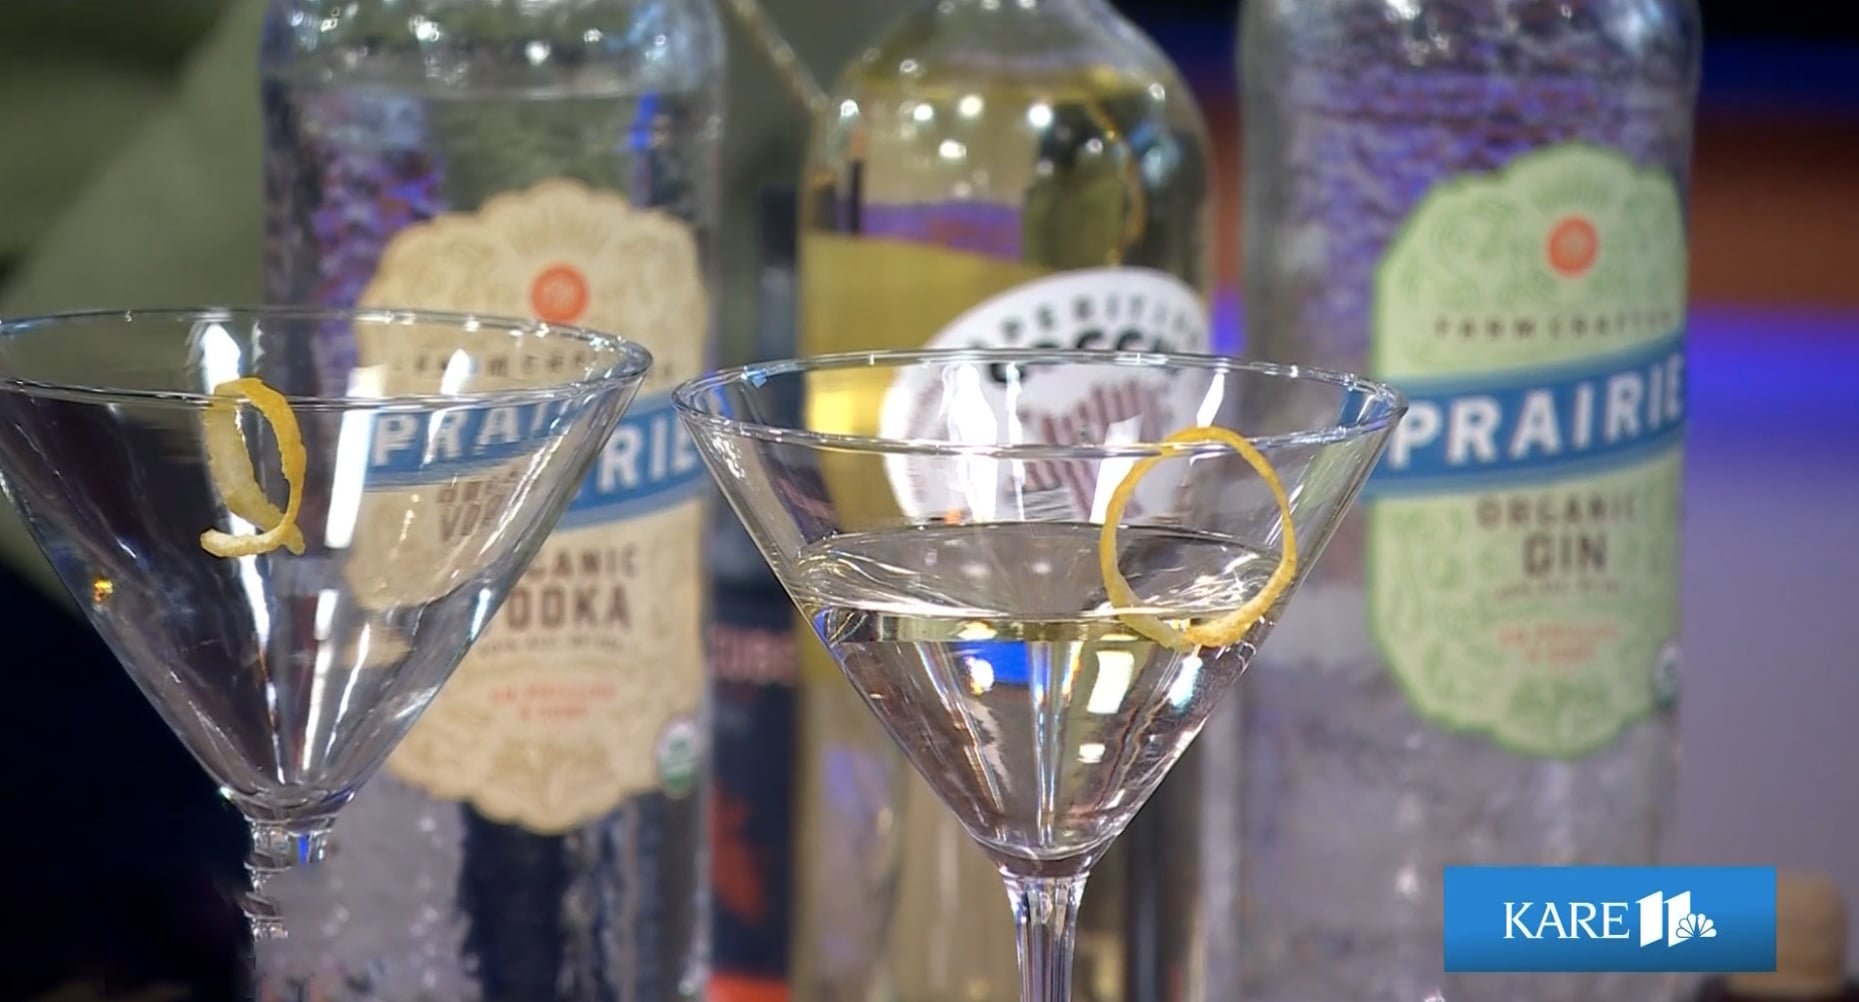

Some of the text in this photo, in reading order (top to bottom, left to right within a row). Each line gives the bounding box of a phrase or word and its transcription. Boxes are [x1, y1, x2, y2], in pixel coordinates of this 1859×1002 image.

[1388, 353, 1685, 470] PRAIRIE
[1523, 531, 1608, 578] GIN
[500, 584, 634, 631] ODKA
